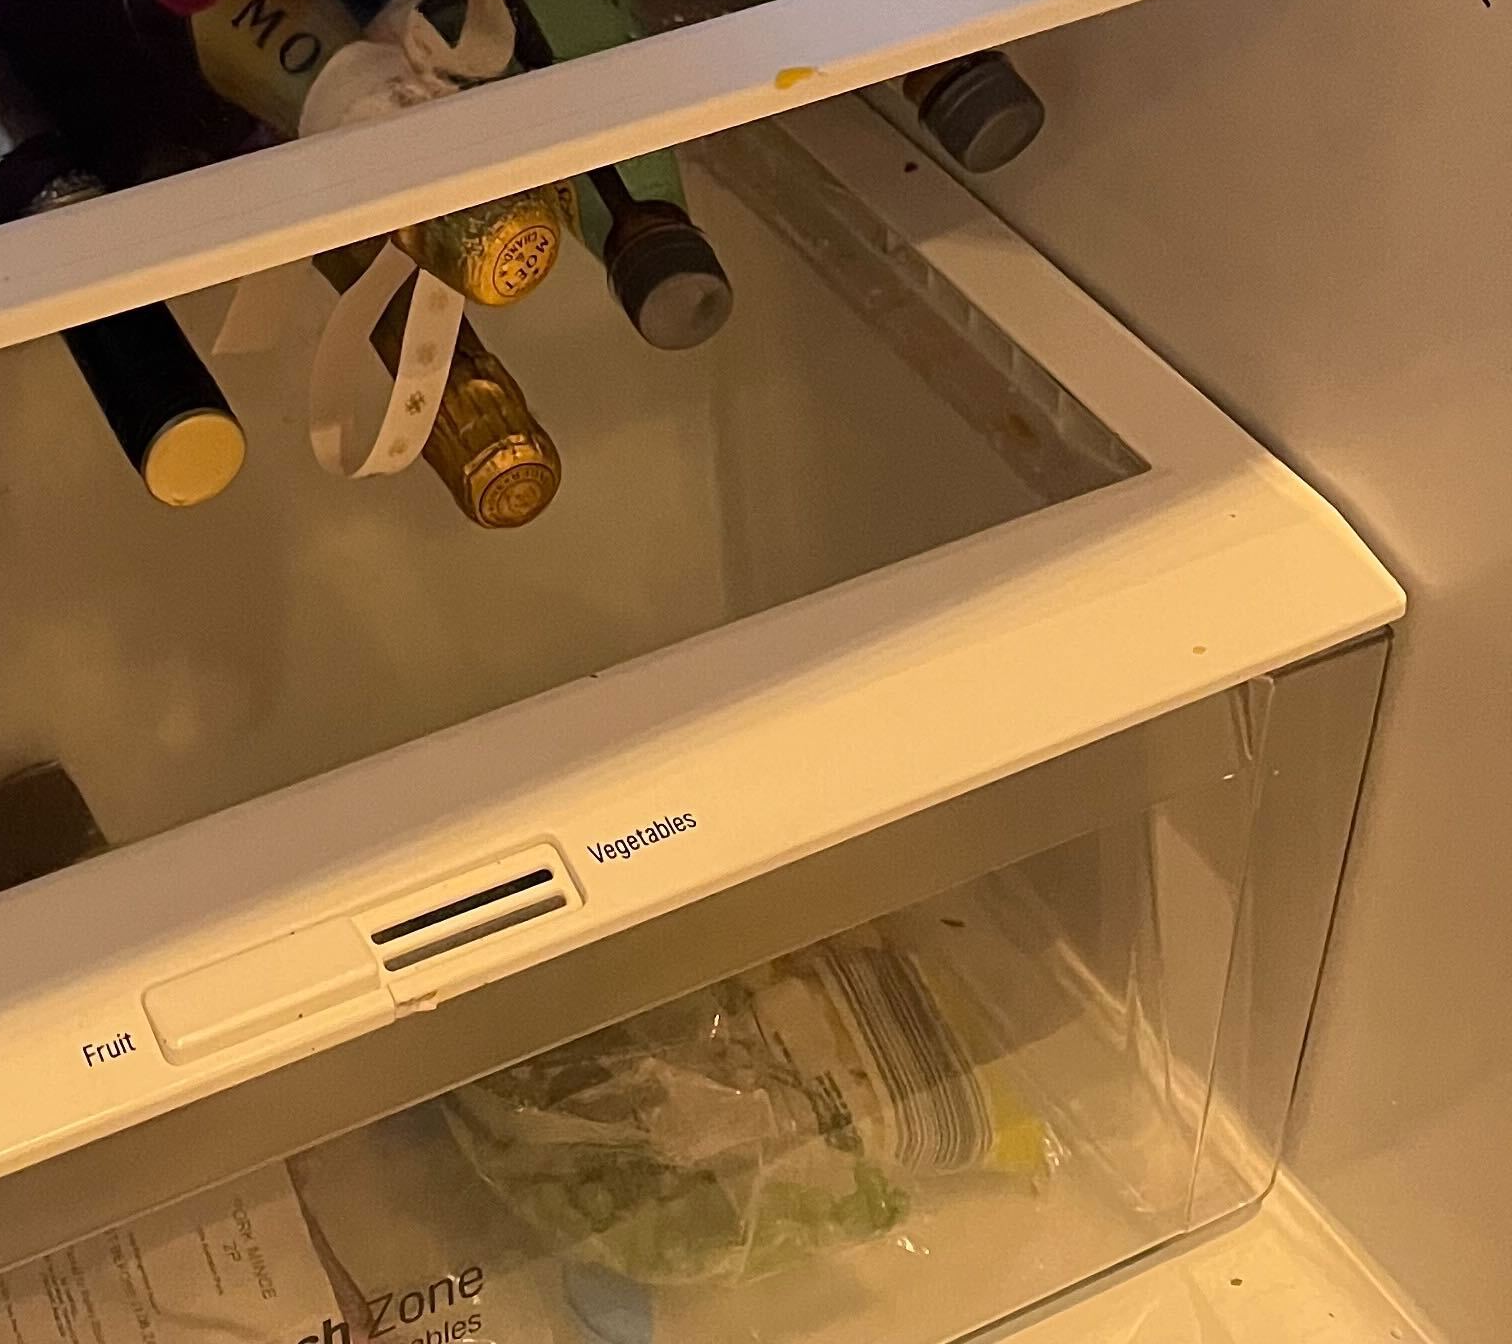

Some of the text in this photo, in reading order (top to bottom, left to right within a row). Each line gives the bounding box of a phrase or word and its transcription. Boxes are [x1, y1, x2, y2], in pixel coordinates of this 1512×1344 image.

[586, 809, 700, 867] Vegetables
[81, 1030, 138, 1069] Fruit
[246, 1244, 279, 1301] MINCE
[366, 1264, 486, 1341] Zone
